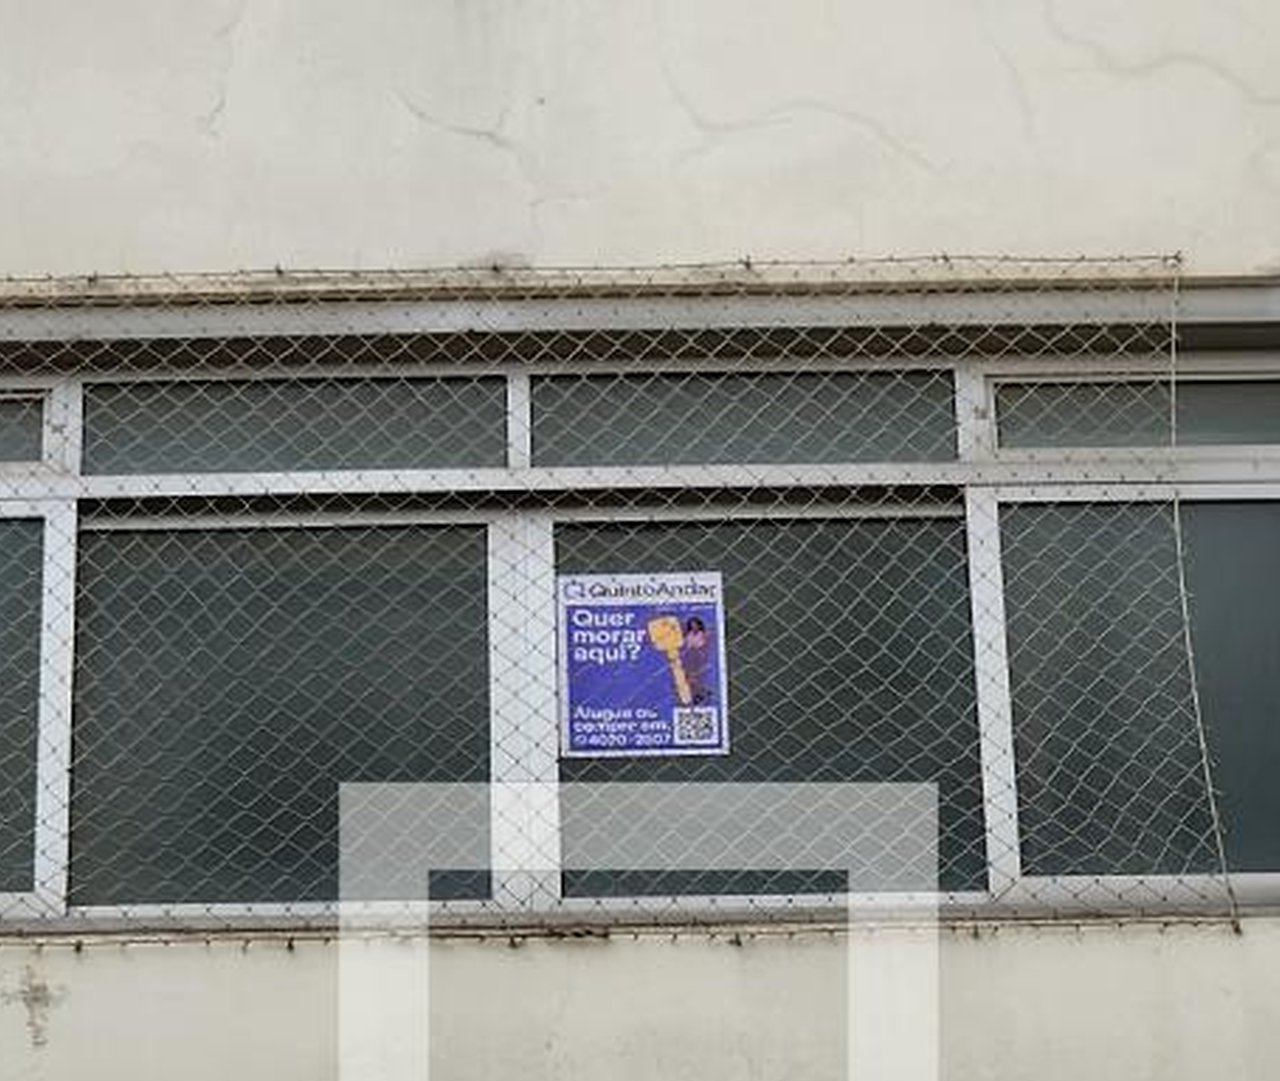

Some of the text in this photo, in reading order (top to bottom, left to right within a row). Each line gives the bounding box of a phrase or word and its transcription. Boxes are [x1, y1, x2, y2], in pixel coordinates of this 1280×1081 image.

[589, 581, 717, 598] QuintoAndar
[572, 609, 635, 626] Quer
[573, 630, 646, 644] morar
[574, 644, 640, 664] aqui?
